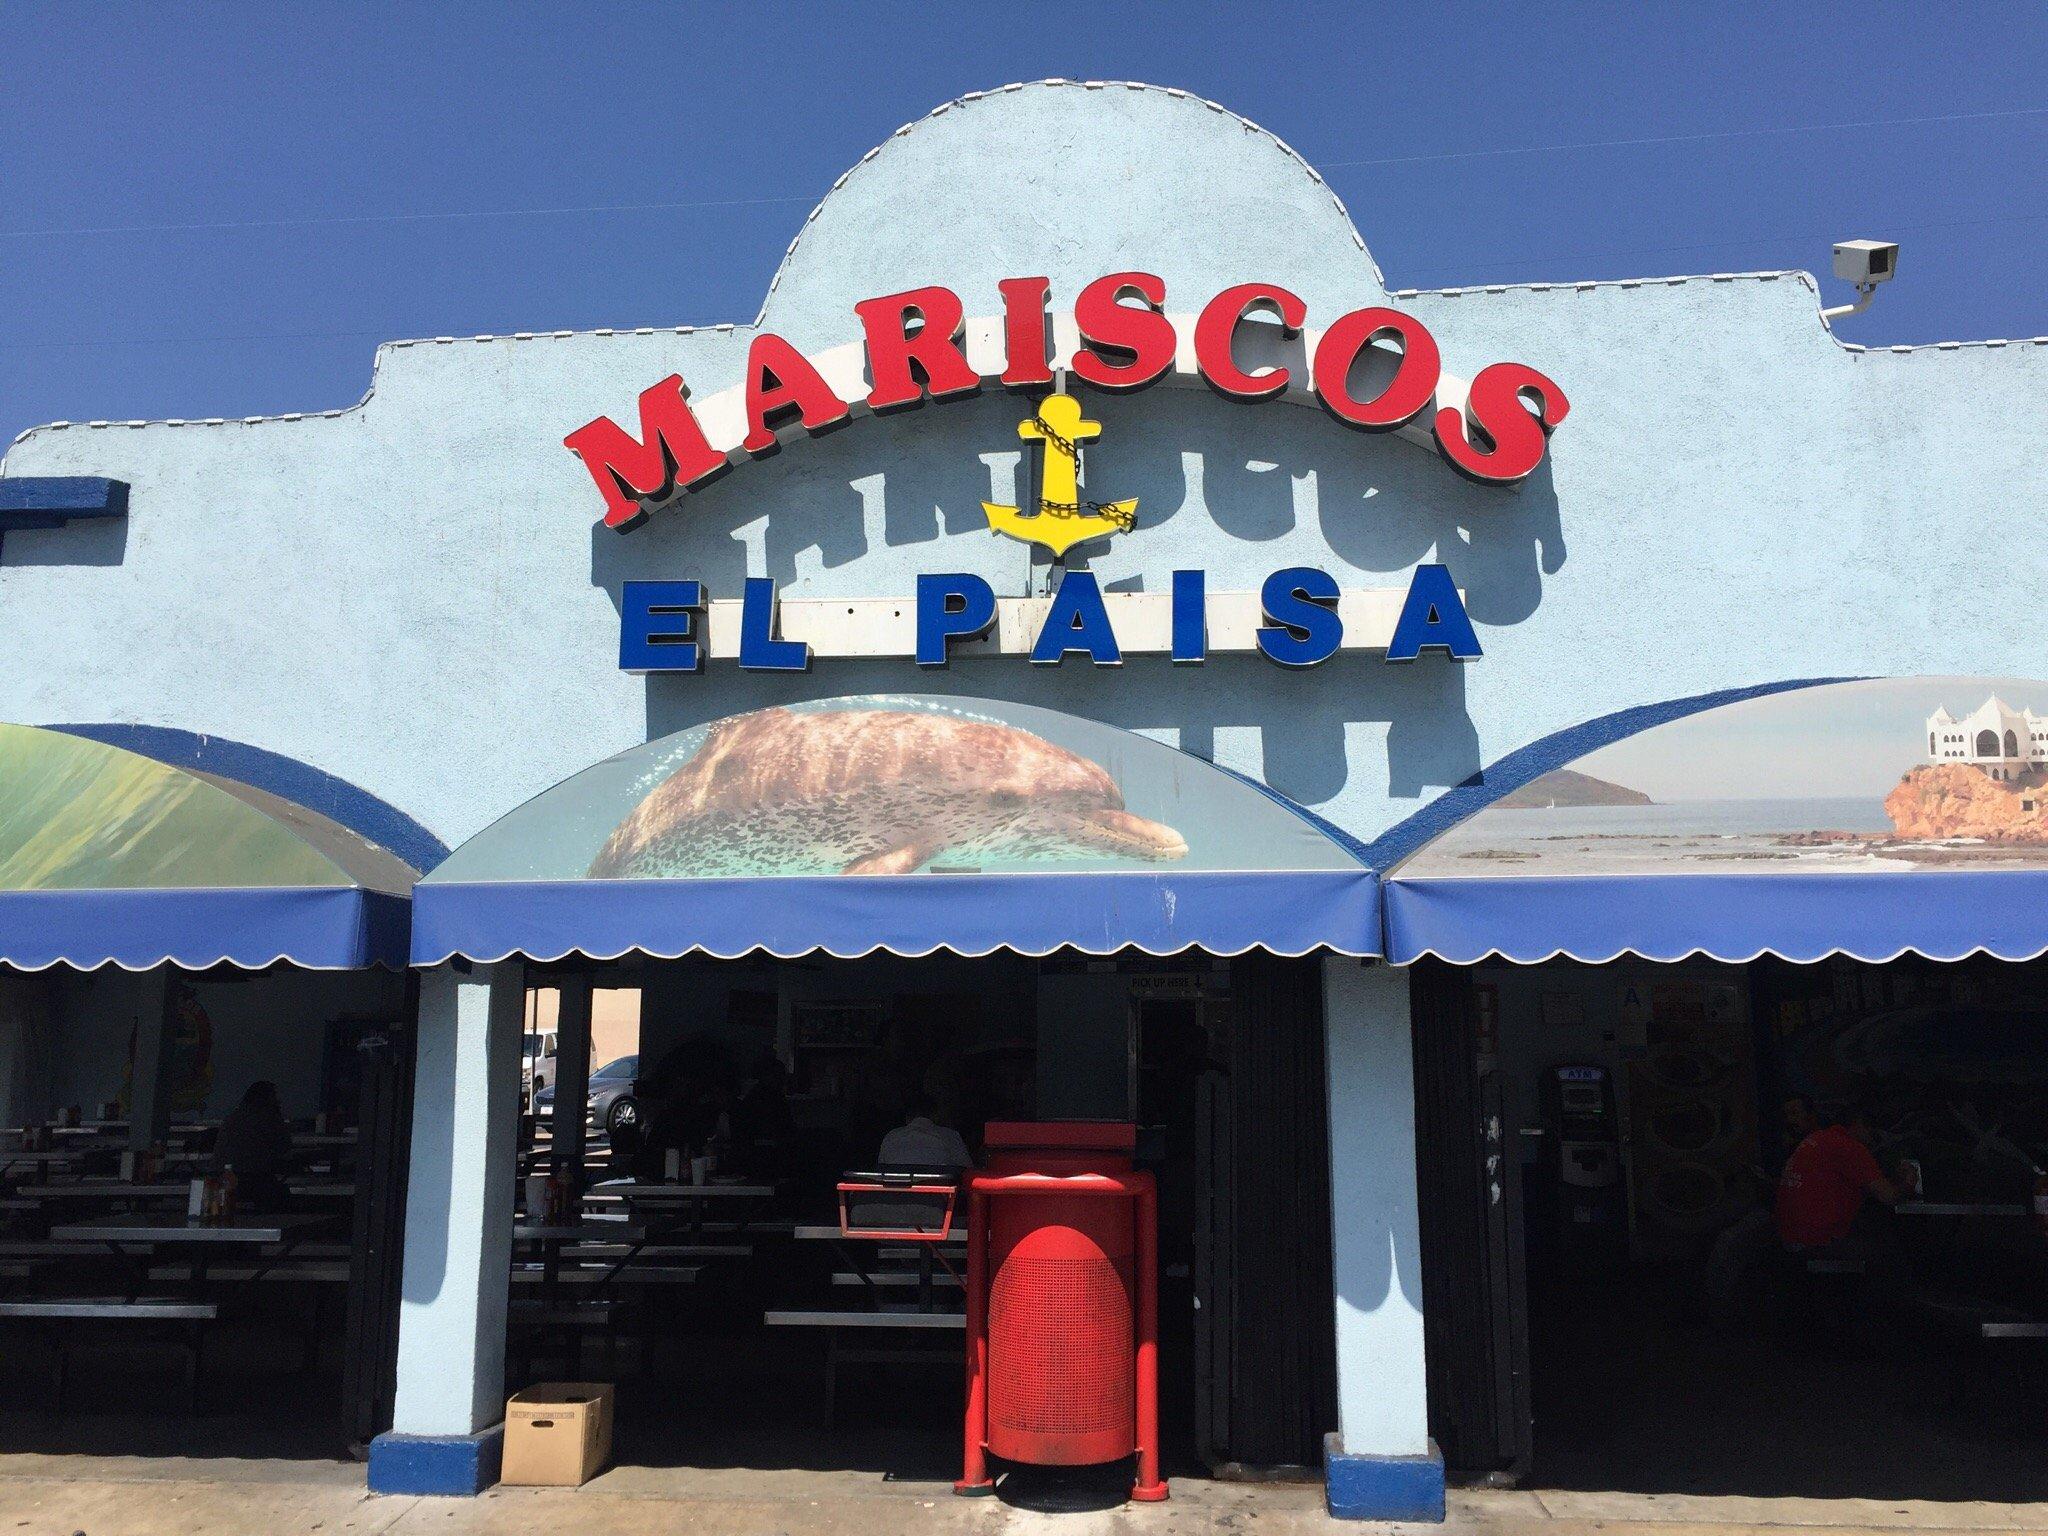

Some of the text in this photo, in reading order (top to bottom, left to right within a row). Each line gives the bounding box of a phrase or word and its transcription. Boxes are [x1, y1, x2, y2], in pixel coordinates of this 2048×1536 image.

[564, 272, 1569, 527] MARISCOS
[619, 563, 1482, 671] EL PAISA
[1132, 977, 1151, 988] PICK
[1153, 977, 1166, 988] UP
[1568, 1069, 1592, 1078] ATM
